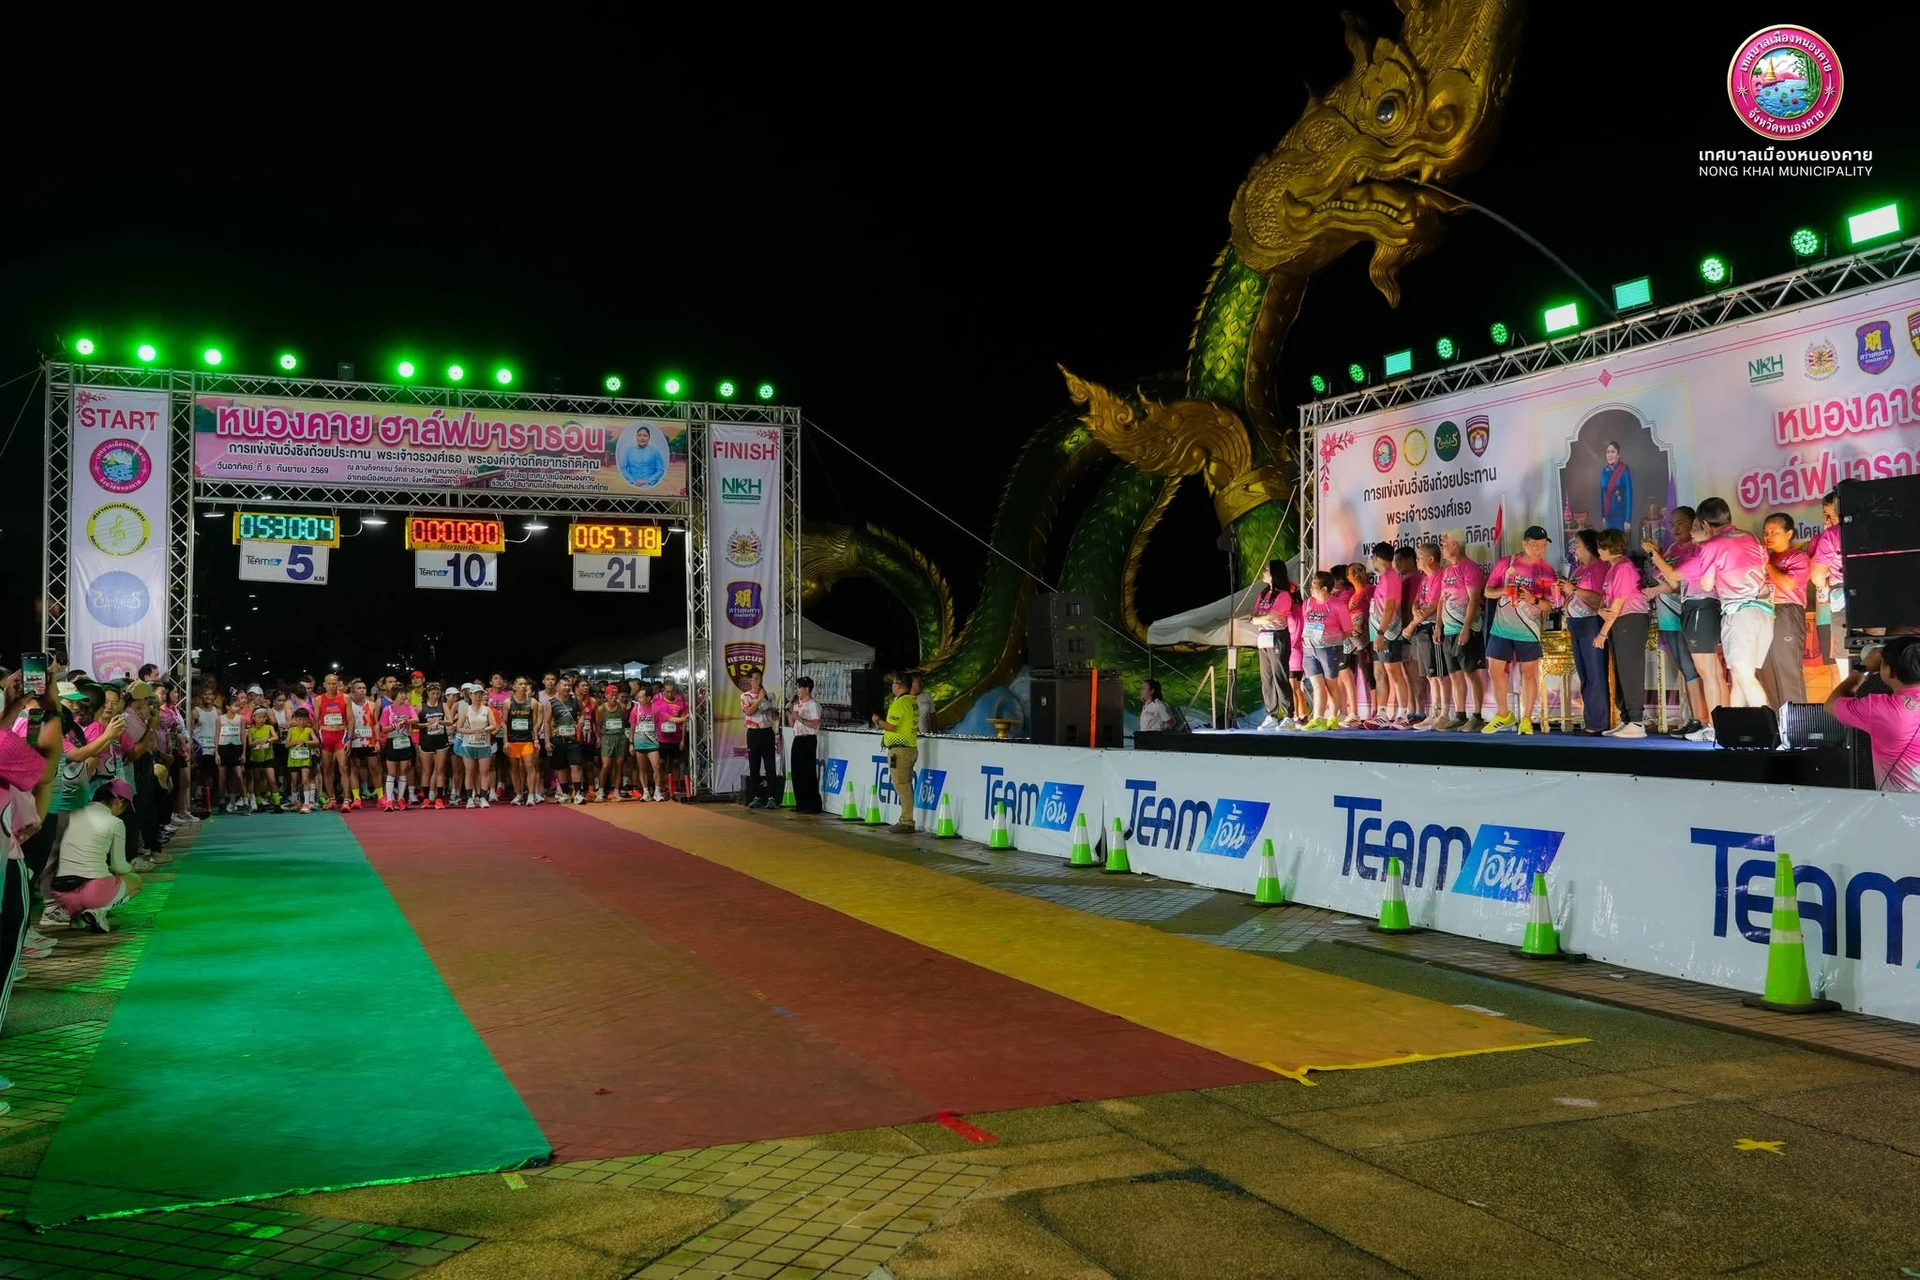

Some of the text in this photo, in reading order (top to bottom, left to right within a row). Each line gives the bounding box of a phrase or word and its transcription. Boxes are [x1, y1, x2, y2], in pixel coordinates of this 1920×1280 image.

[1748, 354, 1784, 377] NKH
[80, 407, 160, 431] START
[217, 405, 603, 452] หนองคาย ฮาล์ฟมาราธอน
[228, 440, 600, 473] การแข่งขันวิ่งชิงถ้วยประทาน พระเจ้าวรวงศ์เธอ พระองค์เจ้าอทิตยาทรกิติคุณ
[713, 441, 775, 461] FINISH
[217, 461, 254, 472] วันอาทิตย์
[266, 464, 272, 472] 6
[276, 462, 308, 475] กันยายน
[310, 465, 329, 475] 2569
[722, 477, 762, 494] NKH
[1363, 466, 1497, 502] การแข่งขันวิ่งชิงถ้วยประทาน
[1386, 498, 1472, 525] พระเจ้าวรวงศ์เธอ
[240, 514, 334, 541] 05:30:04
[412, 519, 499, 545] 00:00:00
[575, 525, 656, 549] 00:57:18
[245, 555, 269, 566] TEAM
[286, 545, 314, 581] 5
[418, 567, 439, 577] TEAM
[446, 553, 487, 588] 10
[607, 556, 637, 590] 21
[727, 655, 764, 664] RESCUE
[1124, 779, 1213, 851] TEAM
[1334, 795, 1472, 891] TEAM
